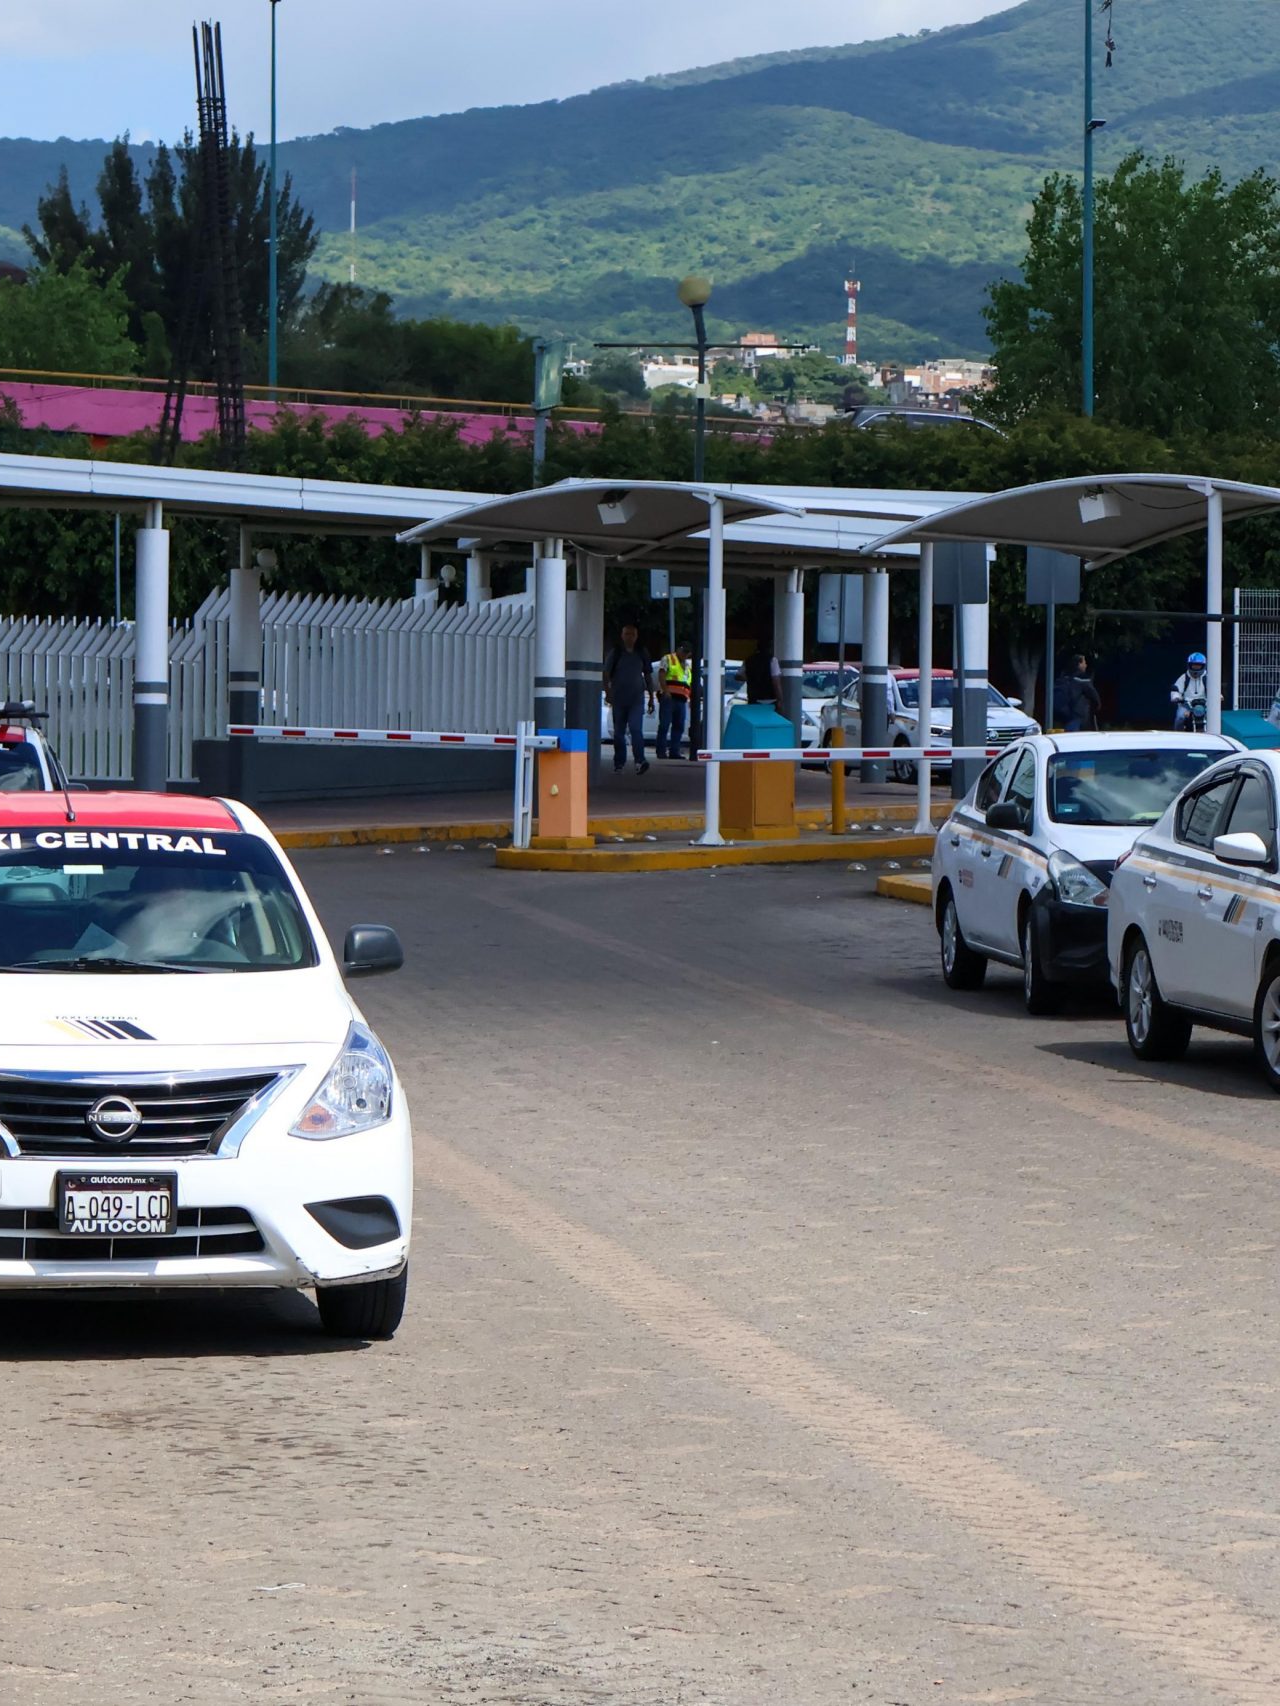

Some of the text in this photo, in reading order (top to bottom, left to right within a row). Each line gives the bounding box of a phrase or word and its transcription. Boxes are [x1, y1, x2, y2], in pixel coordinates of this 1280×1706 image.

[35, 832, 227, 856] CENTRAL
[88, 1114, 141, 1122] NISSAN
[90, 1175, 147, 1184] autocom.mx
[65, 1195, 170, 1220] A-049-LCD
[70, 1219, 167, 1233] AUTOCOM
